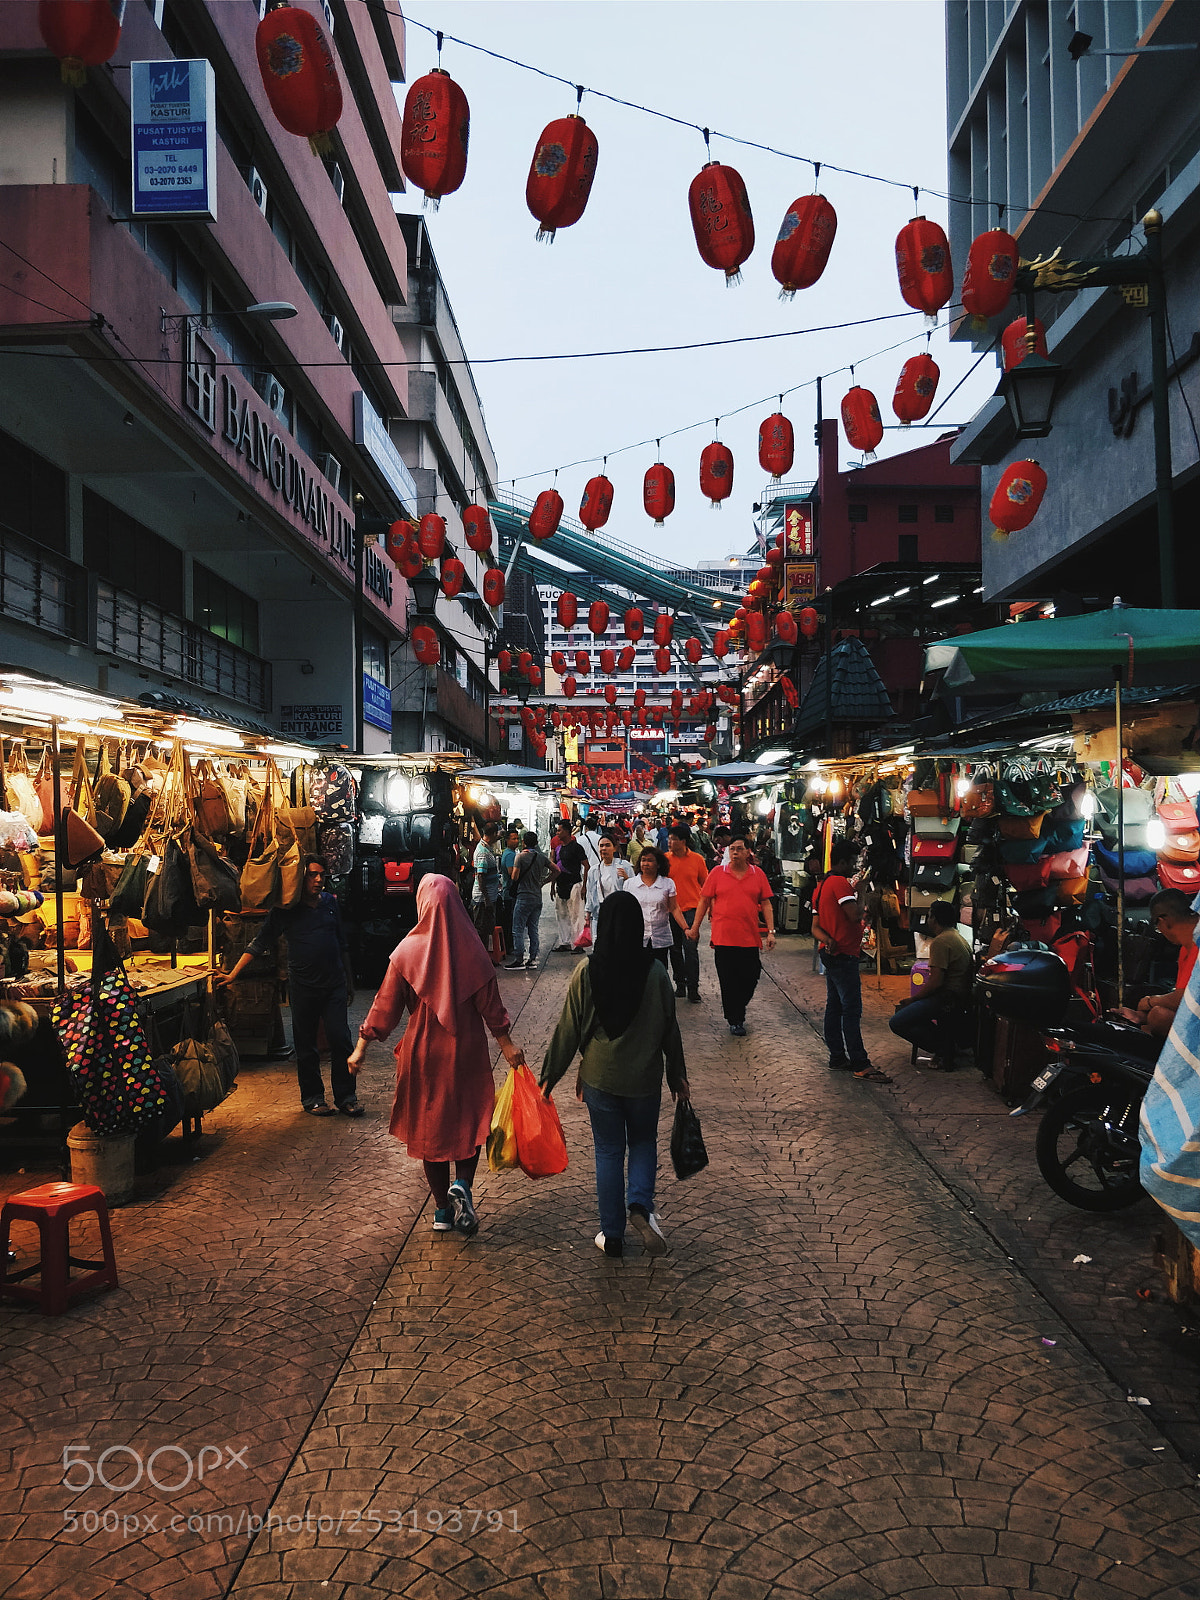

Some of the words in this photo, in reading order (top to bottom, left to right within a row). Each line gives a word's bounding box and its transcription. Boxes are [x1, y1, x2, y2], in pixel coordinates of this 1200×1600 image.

[151, 109, 190, 117] KASTURI
[137, 127, 165, 135] PUSAT
[166, 126, 203, 134] TUISYEN
[152, 137, 189, 146] KASTURI
[144, 166, 176, 174] 03-2070
[149, 178, 175, 186] 03-2070
[222, 374, 328, 541] BANGUNAN
[365, 546, 393, 608] HENG
[788, 571, 814, 587] 168
[281, 721, 342, 732] ENTRANCE
